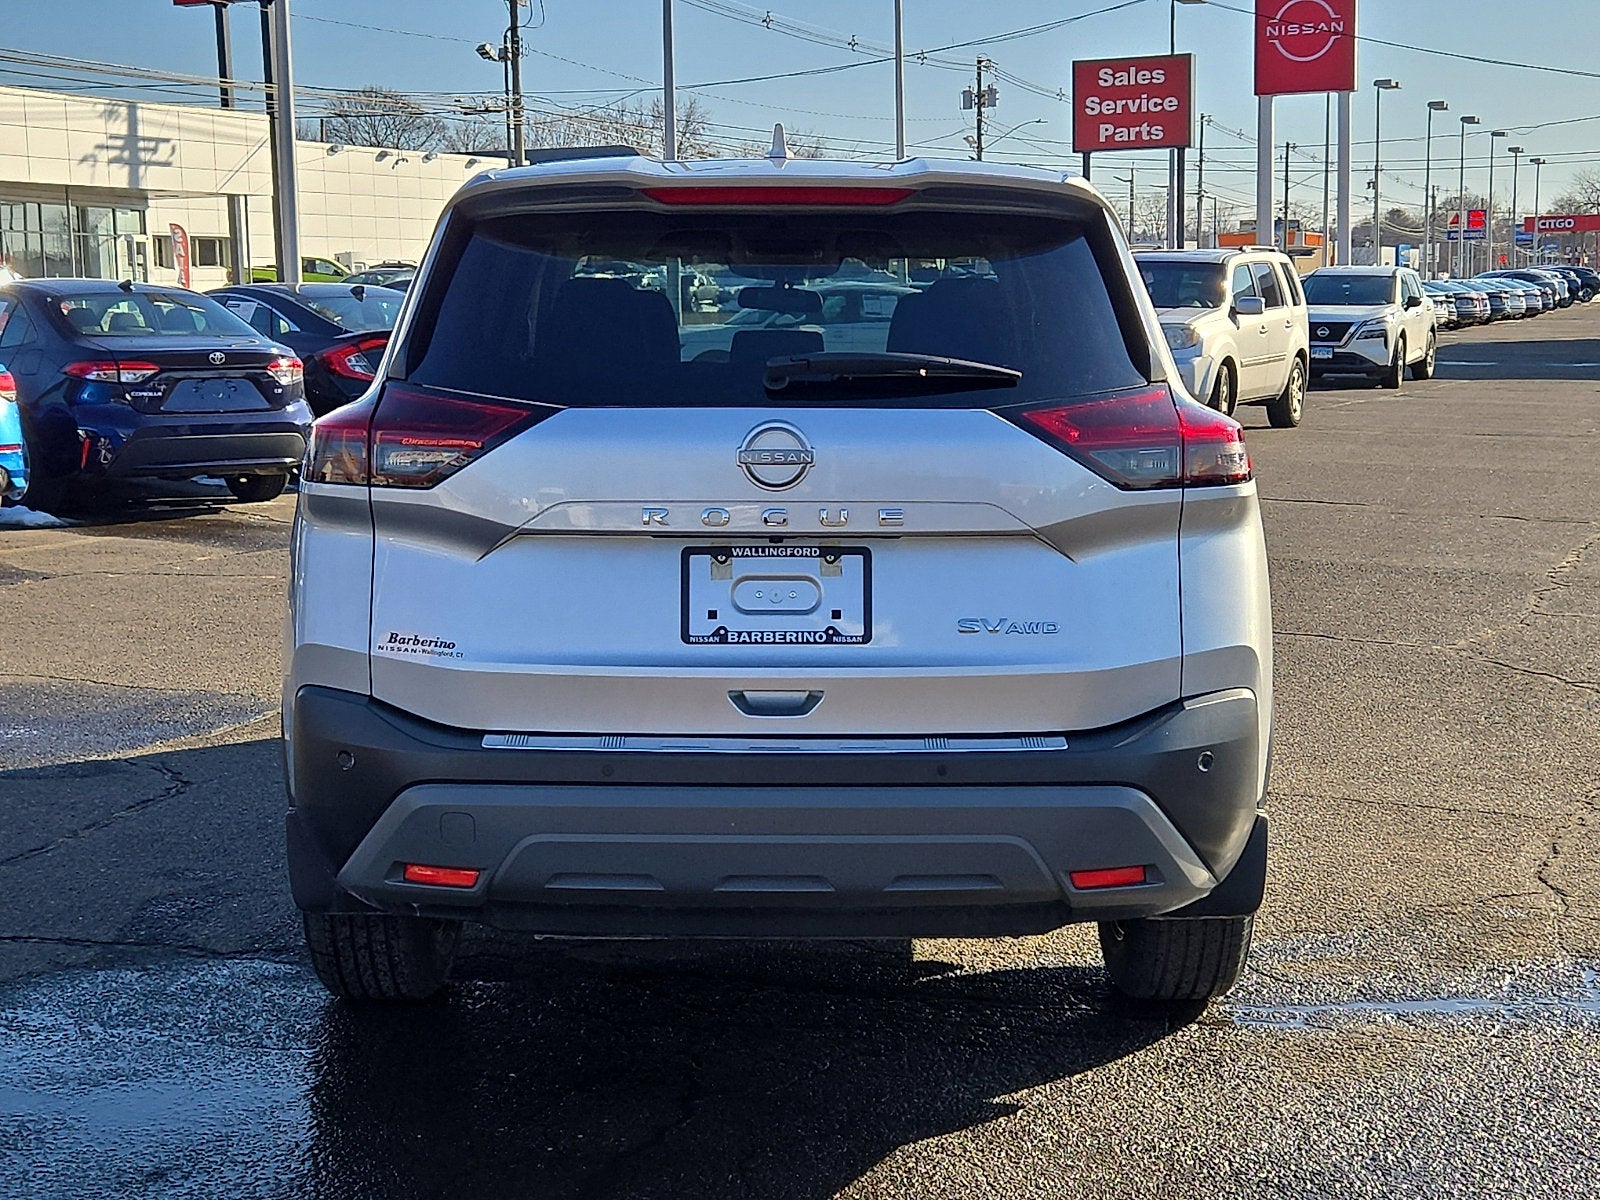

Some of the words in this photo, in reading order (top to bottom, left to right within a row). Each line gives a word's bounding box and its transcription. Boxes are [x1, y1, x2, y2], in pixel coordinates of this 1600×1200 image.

[1266, 21, 1344, 36] NISSAN
[1098, 66, 1165, 86] Sales
[1085, 93, 1178, 115] Service
[1099, 122, 1164, 142] Parts
[1538, 219, 1575, 229] CITGO
[740, 452, 812, 463] NISSAN
[641, 508, 904, 526] ROGUE
[731, 547, 820, 557] WALLINGFORD
[957, 617, 1007, 634] SV
[1005, 621, 1061, 635] AWD
[387, 632, 455, 649] Barberino
[727, 631, 826, 643] BARBERINO
[377, 645, 417, 653] NISSAN
